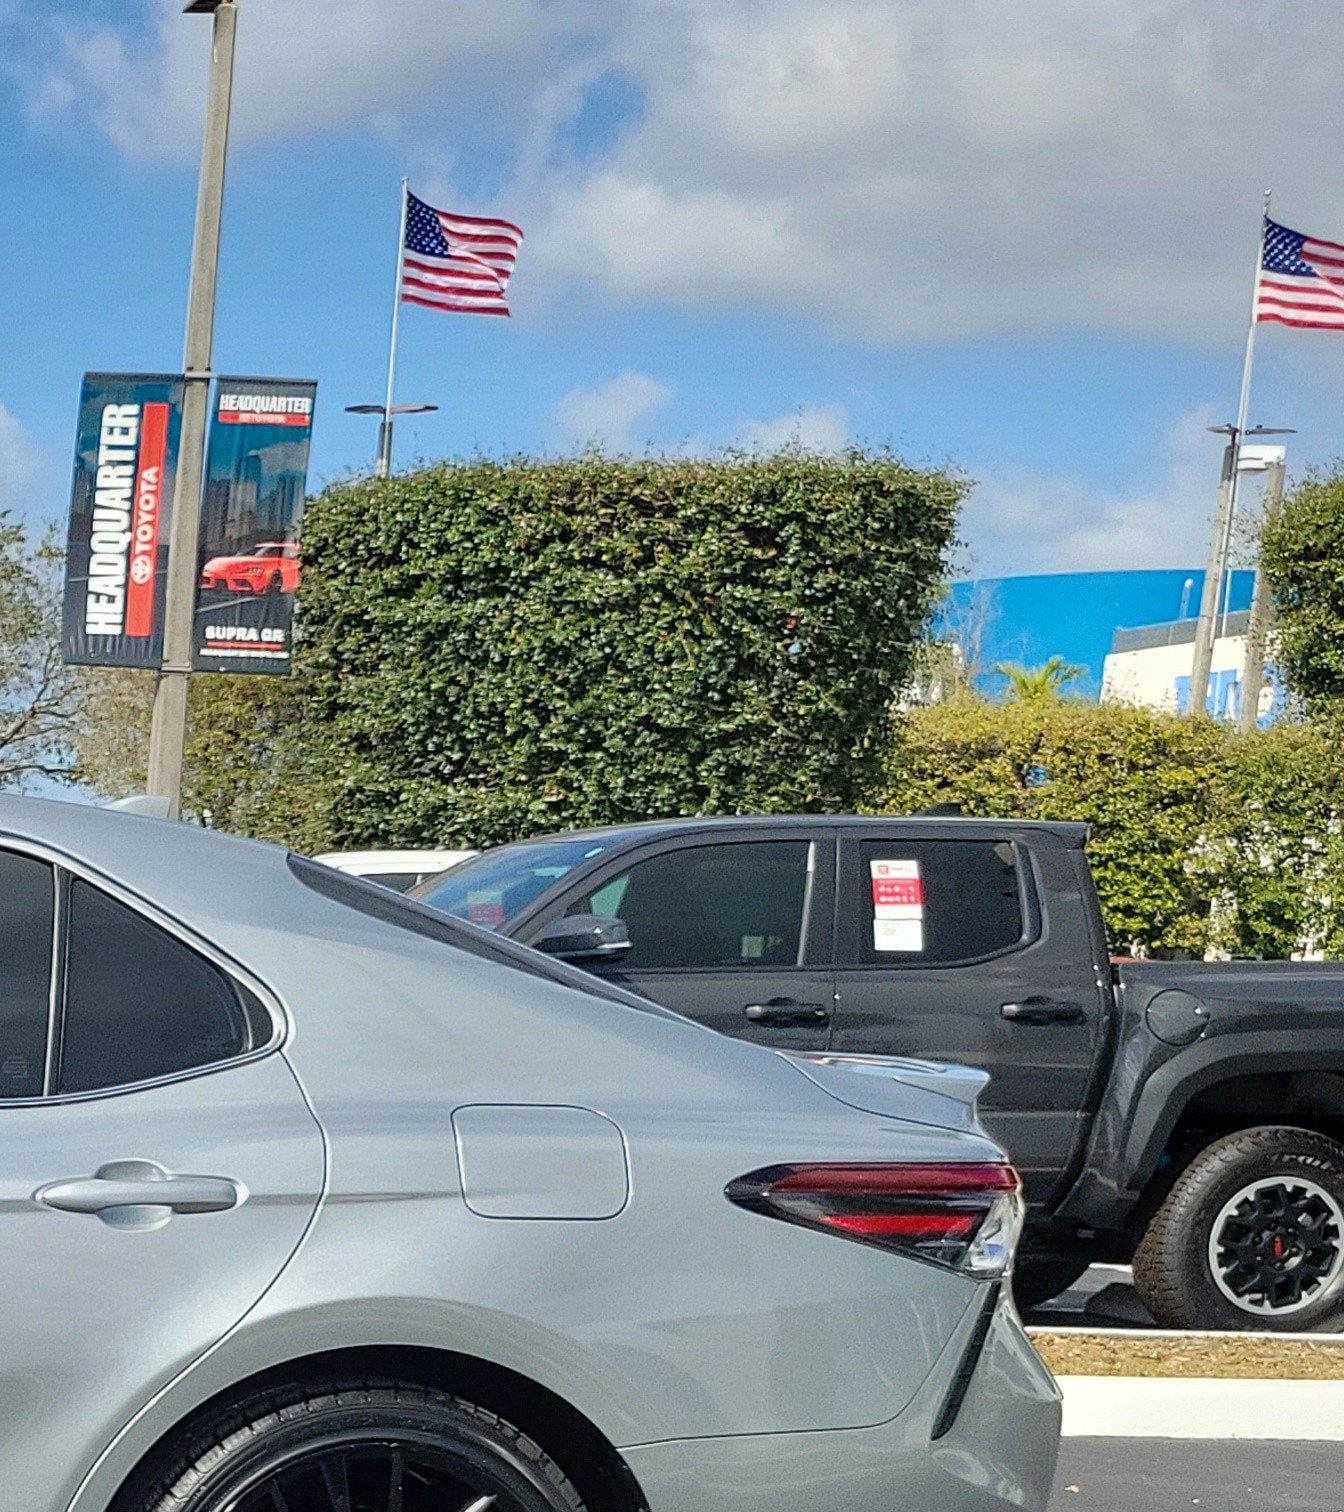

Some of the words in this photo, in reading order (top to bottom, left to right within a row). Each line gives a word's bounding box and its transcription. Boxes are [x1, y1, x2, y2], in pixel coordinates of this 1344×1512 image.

[219, 394, 312, 414] HEADQUARTER
[85, 403, 141, 635] HEADQUARTER
[135, 466, 160, 555] TOYOTA
[204, 625, 260, 642] SUPRA
[260, 627, 286, 643] GR
